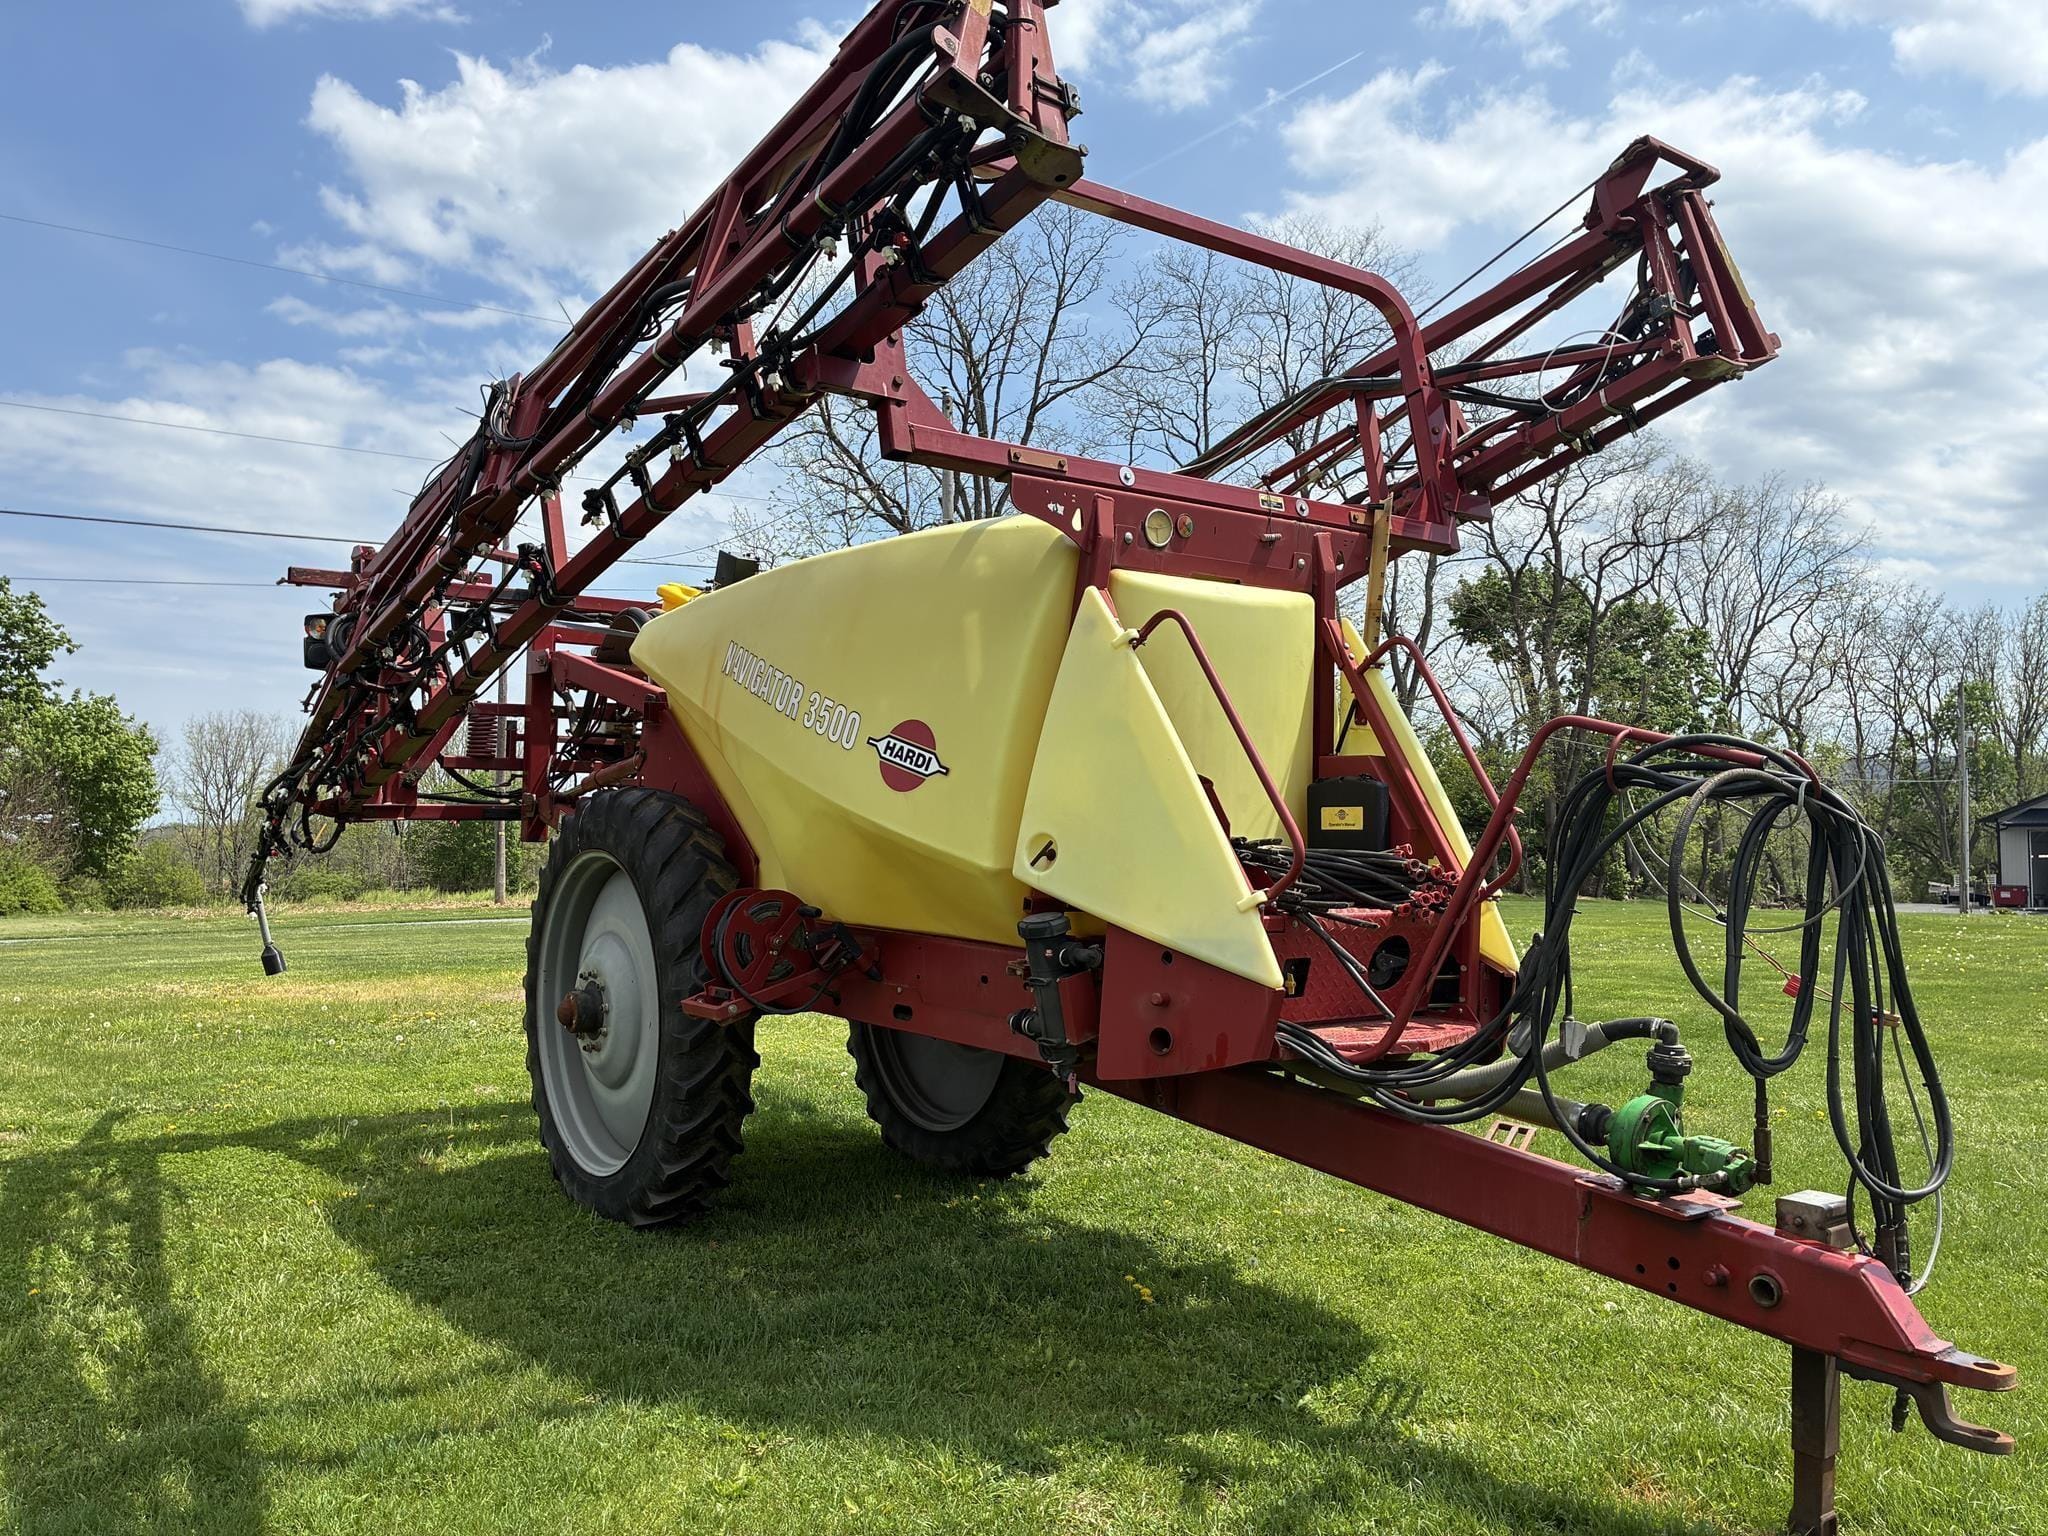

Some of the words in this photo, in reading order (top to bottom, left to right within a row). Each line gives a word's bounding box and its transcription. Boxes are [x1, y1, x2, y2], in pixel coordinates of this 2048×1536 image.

[721, 640, 804, 721] NAVIGATOR
[803, 691, 861, 750] 3500
[883, 740, 932, 772] HARDI
